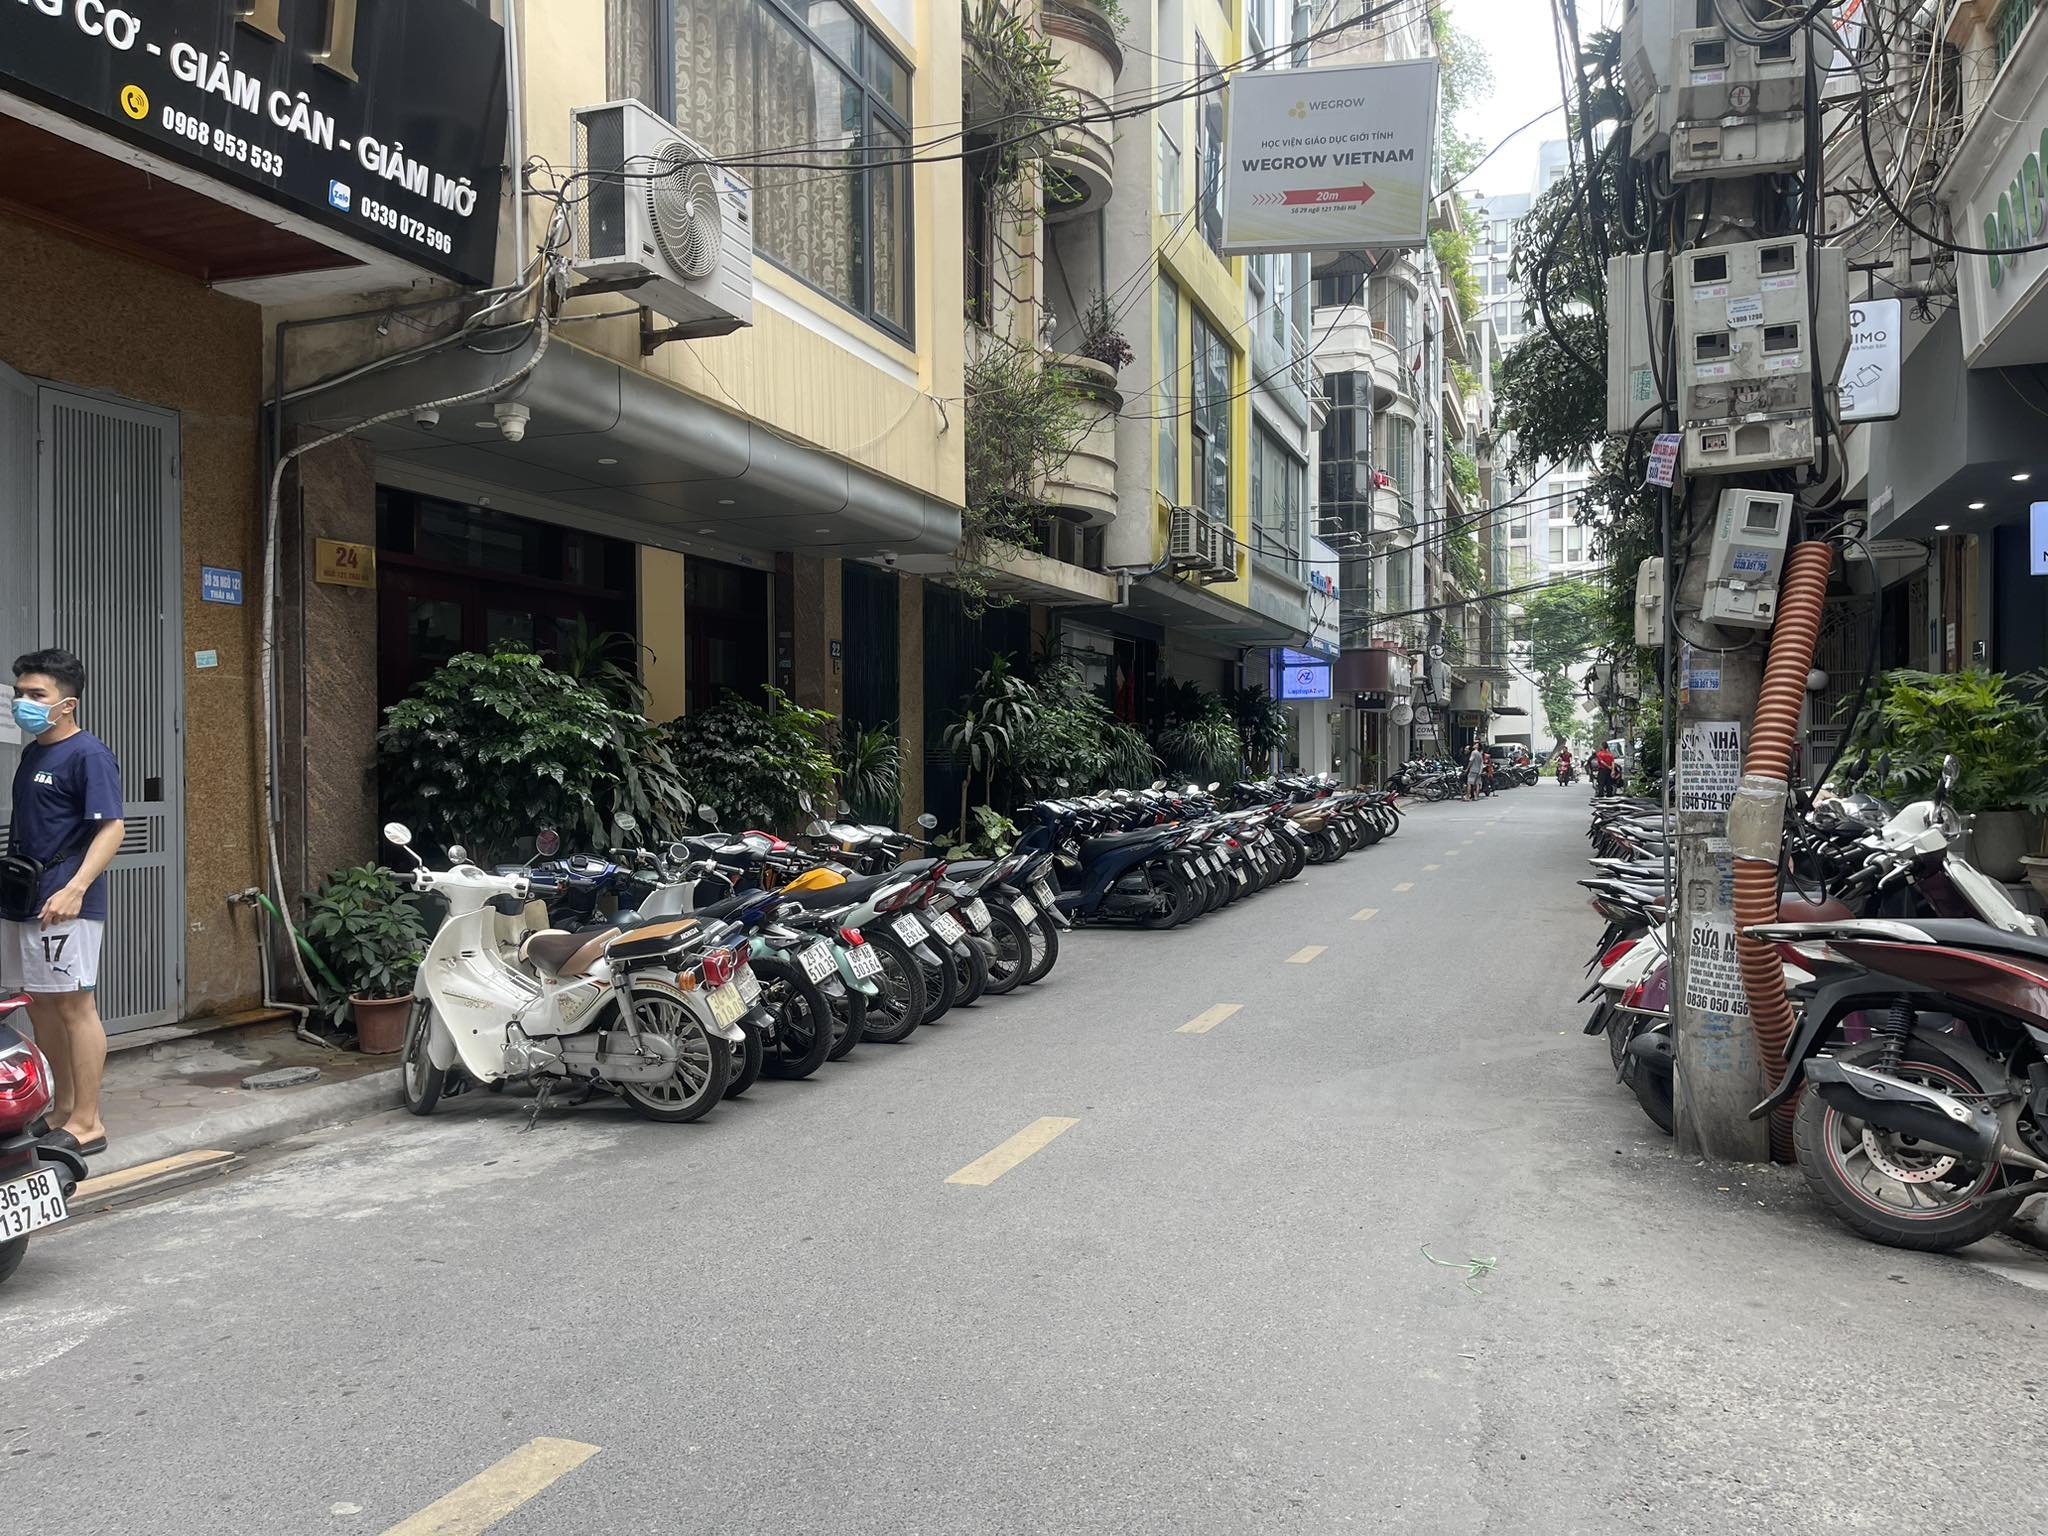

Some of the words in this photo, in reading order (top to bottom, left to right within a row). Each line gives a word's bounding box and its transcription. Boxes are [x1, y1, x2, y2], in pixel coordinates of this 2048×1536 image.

[1309, 97, 1365, 111] WEGROW
[170, 42, 261, 115] GIẢM
[268, 90, 335, 151] CÂN
[358, 136, 429, 197] GIẢM
[433, 173, 477, 217] MỠ
[1261, 139, 1280, 149] HỌC
[1282, 138, 1303, 148] VIỆN
[1304, 134, 1327, 146] GIÁO
[1329, 134, 1348, 146] DỤC
[1350, 132, 1369, 142] GIỚI
[1371, 130, 1394, 141] TÍNH
[162, 105, 210, 146] 0968
[213, 128, 248, 163] 953
[250, 144, 284, 178] 533
[1242, 154, 1327, 172] WEGROW
[1333, 148, 1414, 166] VIETNAM
[1316, 191, 1339, 201] 20m
[361, 196, 398, 230] 0339
[400, 214, 425, 243] 072
[426, 226, 452, 254] 596
[1850, 331, 1887, 345] IMO
[335, 547, 358, 569] 24
[1709, 727, 1739, 749] NHÀ
[680, 927, 700, 940] HONDA
[1691, 921, 1719, 950] SỬA
[41, 934, 70, 963] 17
[803, 945, 827, 966] 29-X1
[808, 955, 837, 982] 510.35
[853, 958, 881, 978] 303.64
[1686, 992, 1708, 1009] 0836
[1709, 997, 1729, 1013] 050
[1731, 1000, 1749, 1015] 456
[0, 1196, 62, 1237] 137.40
